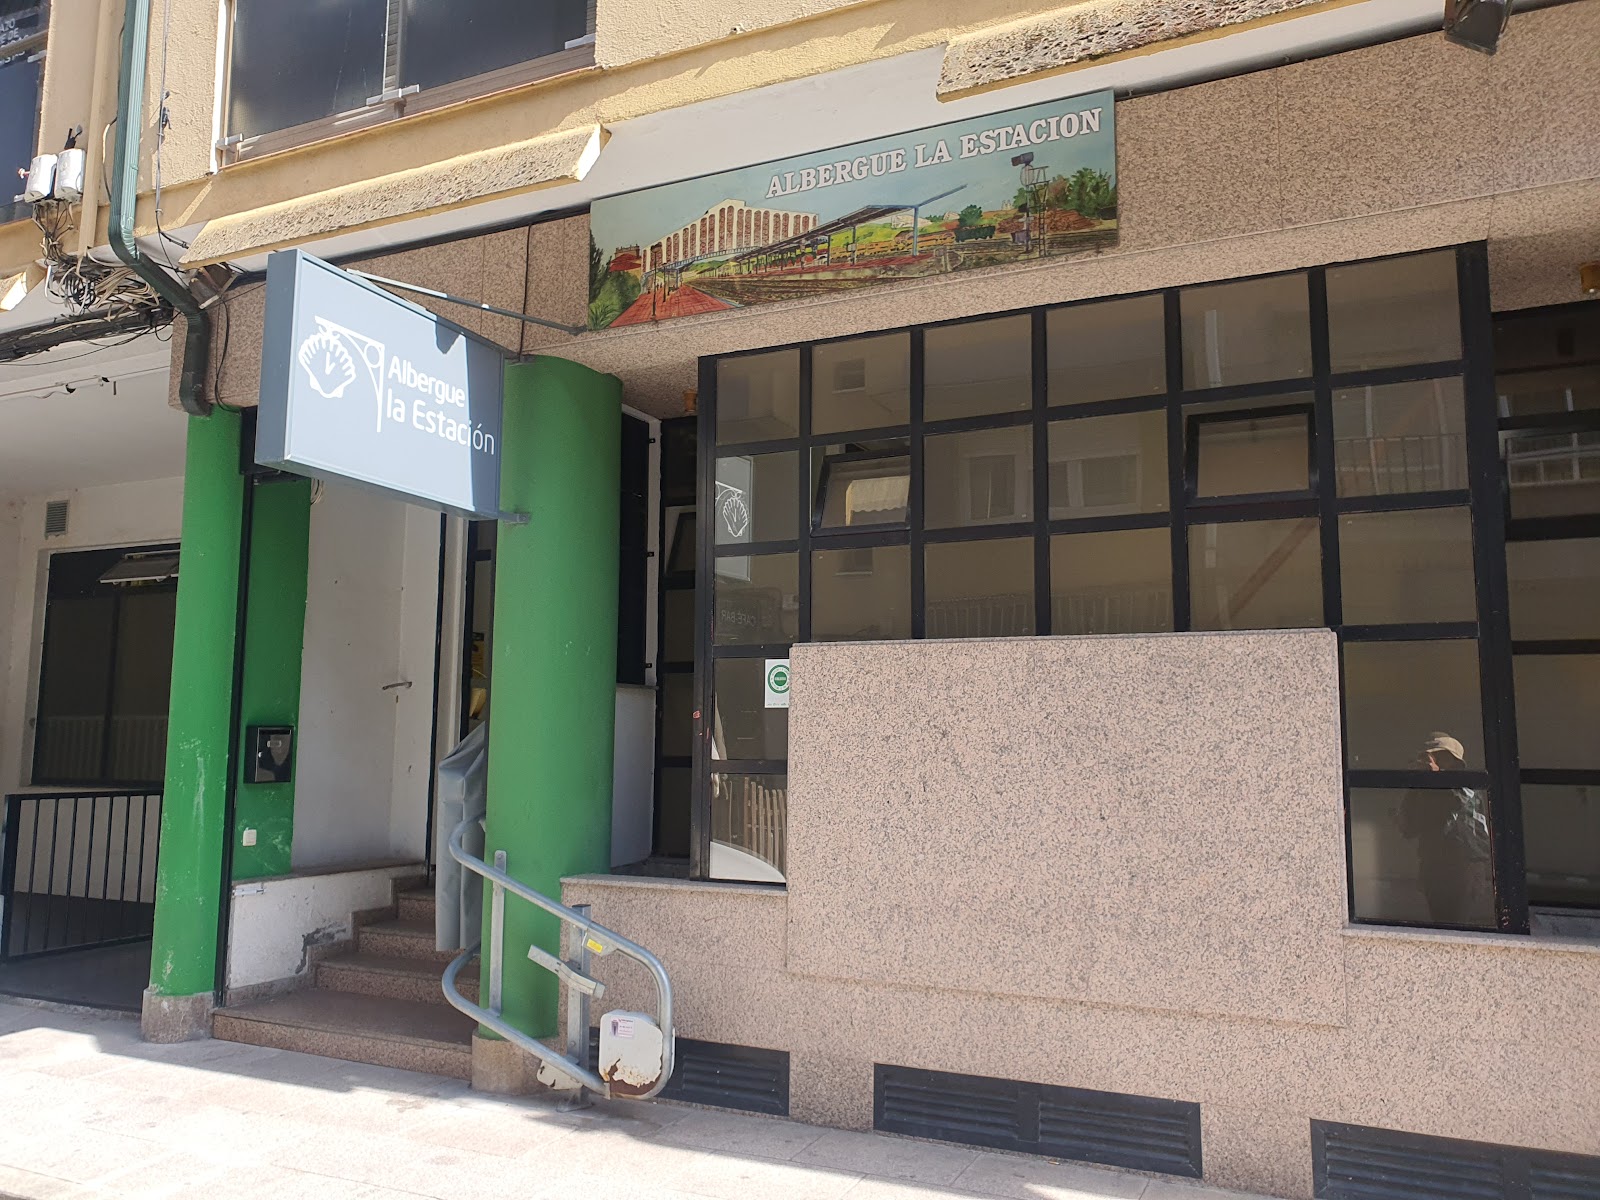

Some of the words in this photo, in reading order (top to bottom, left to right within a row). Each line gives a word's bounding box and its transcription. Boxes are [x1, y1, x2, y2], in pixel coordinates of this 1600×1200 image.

[765, 149, 906, 198] ALBERGUE
[914, 139, 952, 168] LA
[959, 107, 1103, 159] ESTACION
[388, 356, 466, 408] Albergue
[387, 388, 405, 422] la
[412, 399, 495, 455] Estación
